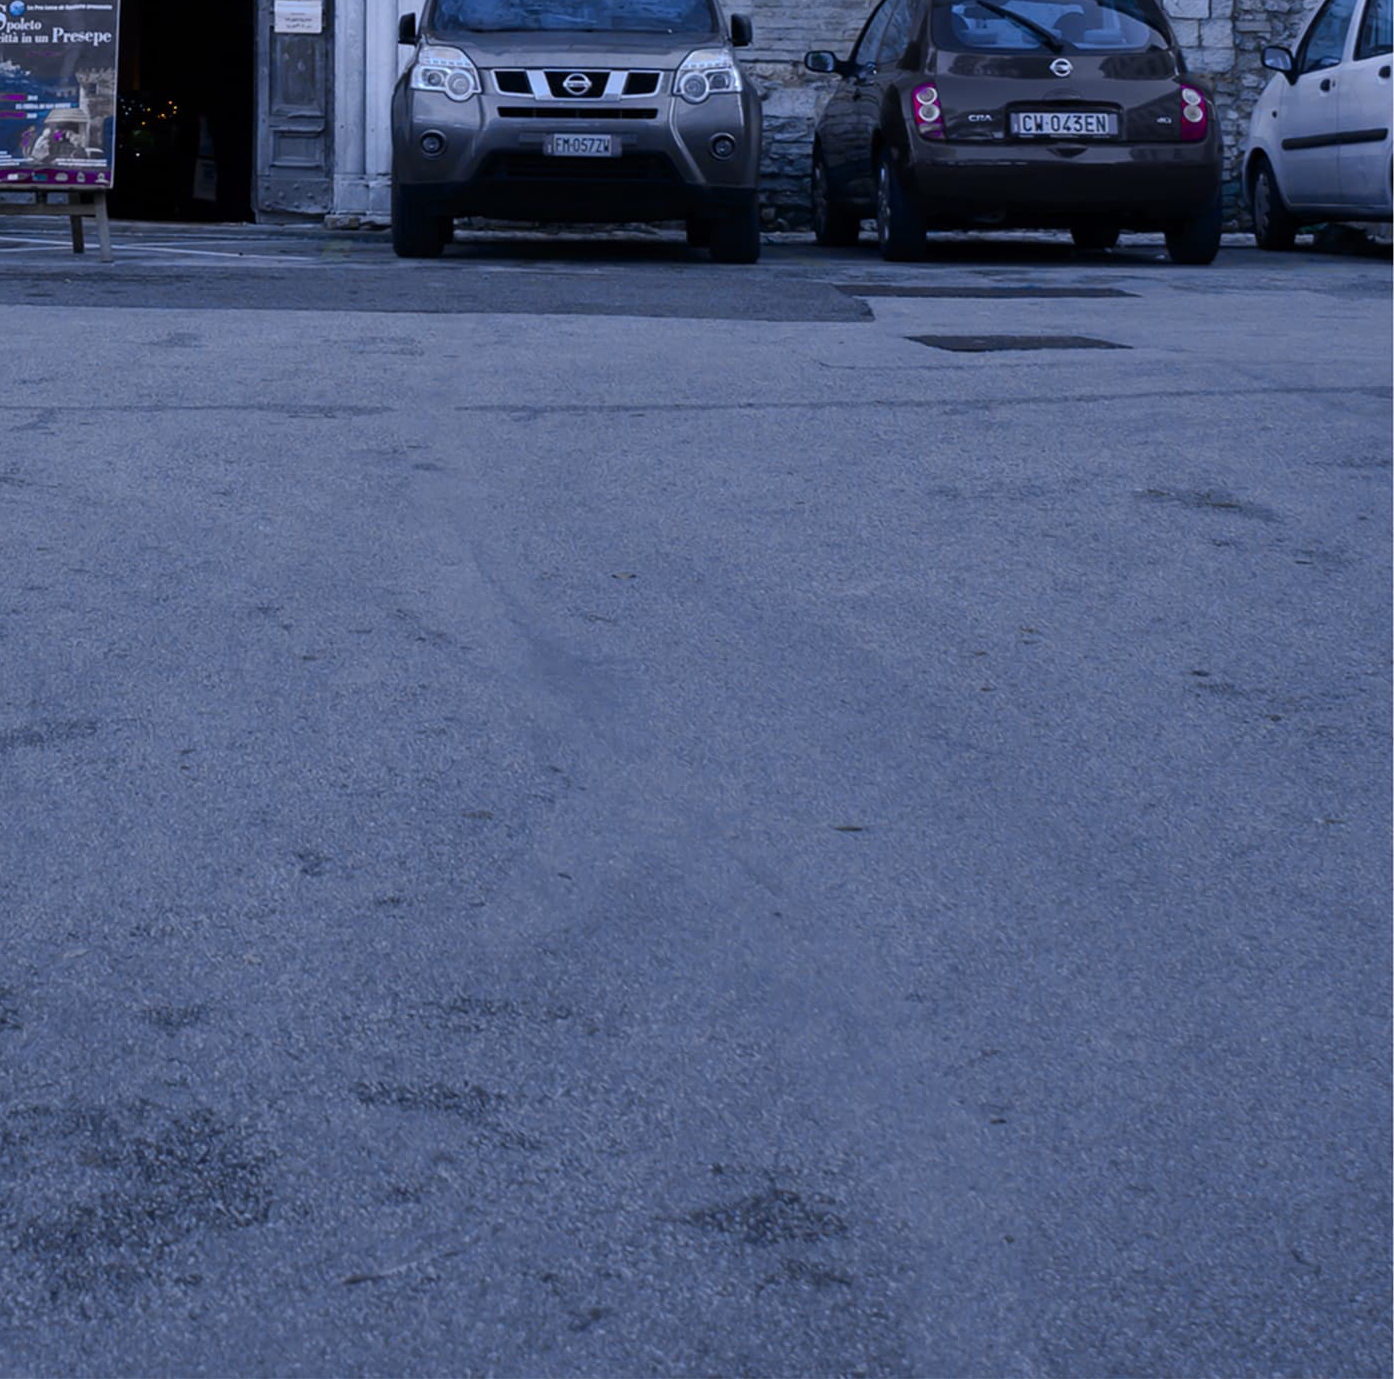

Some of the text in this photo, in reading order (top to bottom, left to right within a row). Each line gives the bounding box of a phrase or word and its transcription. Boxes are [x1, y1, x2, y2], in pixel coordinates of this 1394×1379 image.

[21, 32, 32, 43] in
[35, 35, 49, 43] un
[52, 27, 112, 47] Presepe
[1050, 115, 1106, 133] 043EN
